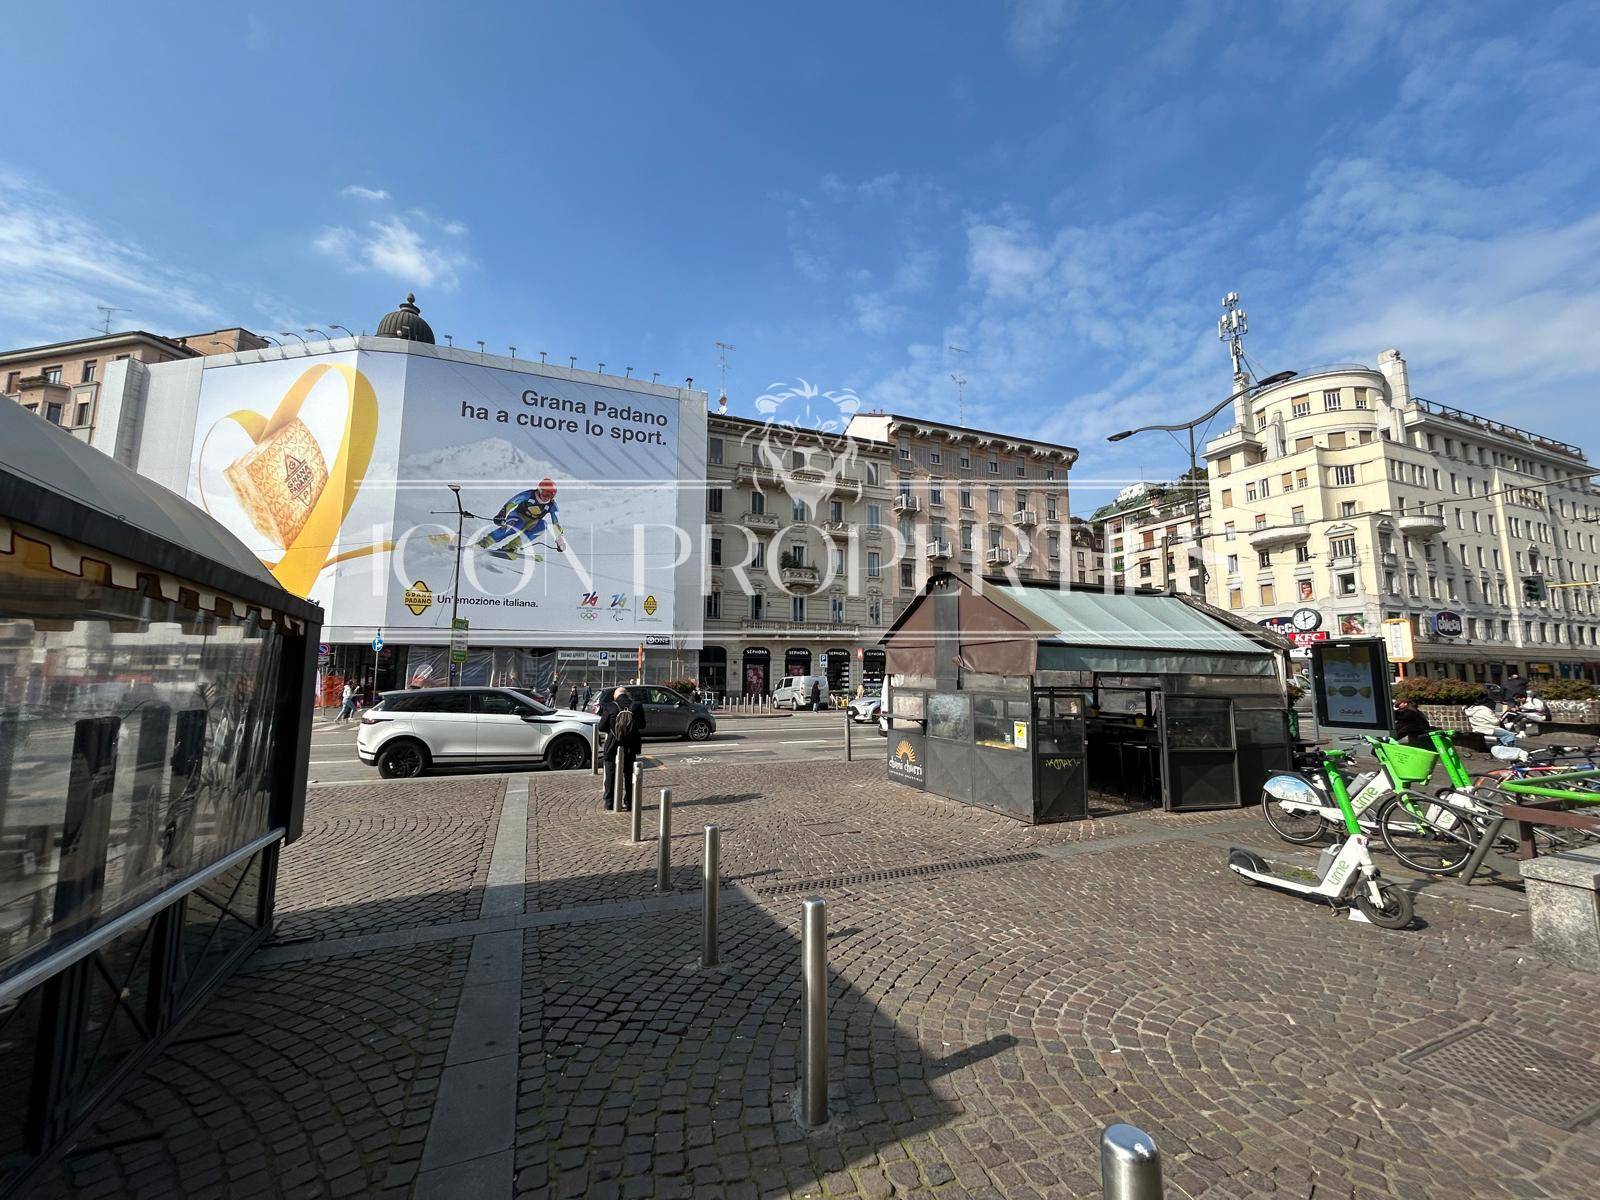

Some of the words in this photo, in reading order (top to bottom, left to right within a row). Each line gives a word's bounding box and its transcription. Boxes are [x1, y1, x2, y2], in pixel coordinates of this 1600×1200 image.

[521, 389, 586, 415] Grana
[594, 401, 668, 427] Padano
[461, 401, 489, 421] ha
[496, 410, 509, 424] a
[516, 412, 579, 433] cuore
[585, 419, 604, 437] lo
[610, 427, 667, 446] sport.
[405, 591, 432, 599] GRANA
[405, 597, 432, 605] PADANO
[503, 598, 539, 608] italiana.
[1295, 632, 1319, 642] KFC
